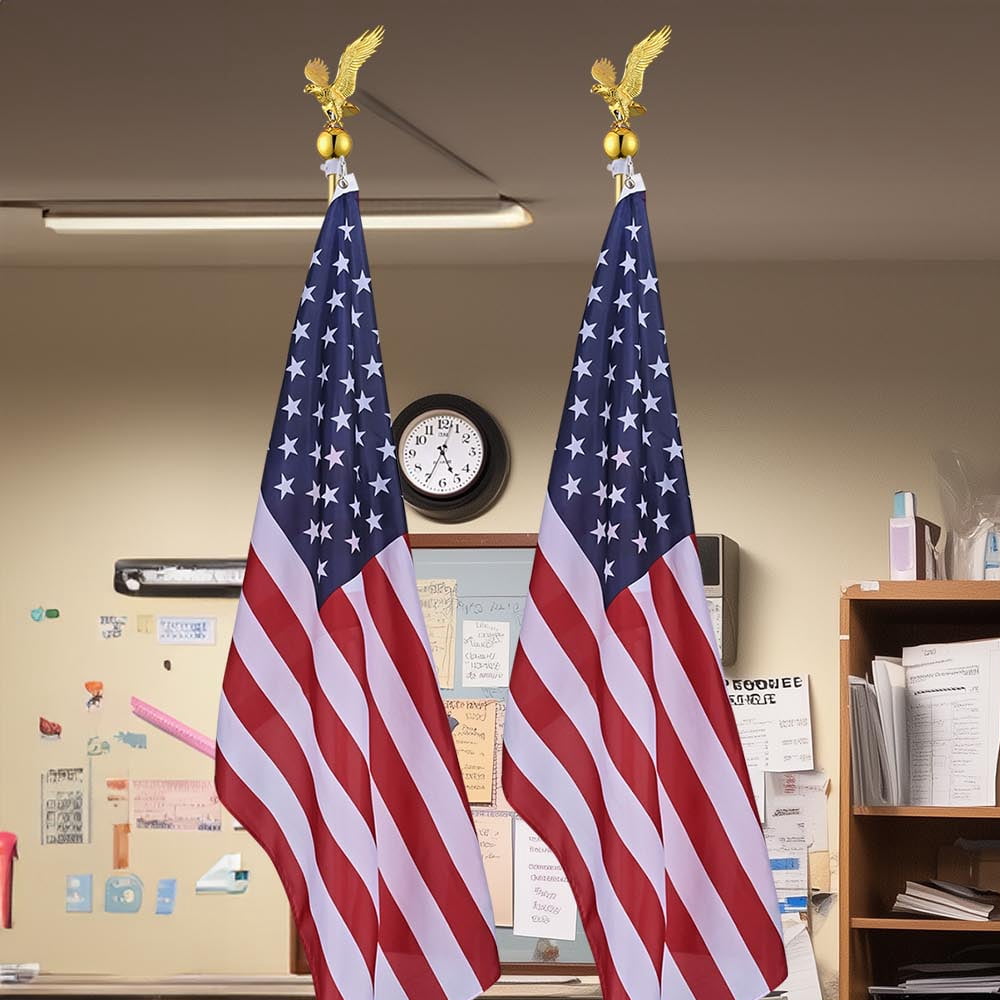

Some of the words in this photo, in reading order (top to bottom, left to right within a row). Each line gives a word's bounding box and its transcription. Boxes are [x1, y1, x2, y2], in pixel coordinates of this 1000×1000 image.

[438, 419, 449, 430] 12
[455, 424, 460, 433] 1
[425, 425, 433, 435] 11
[415, 435, 427, 445] 10
[462, 433, 471, 444] 2
[409, 449, 416, 458] 9
[469, 447, 476, 457] 3
[414, 463, 422, 472] 8
[462, 463, 470, 473] 4
[425, 473, 432, 483] 7
[439, 478, 447, 488] 6
[453, 473, 461, 484] 5
